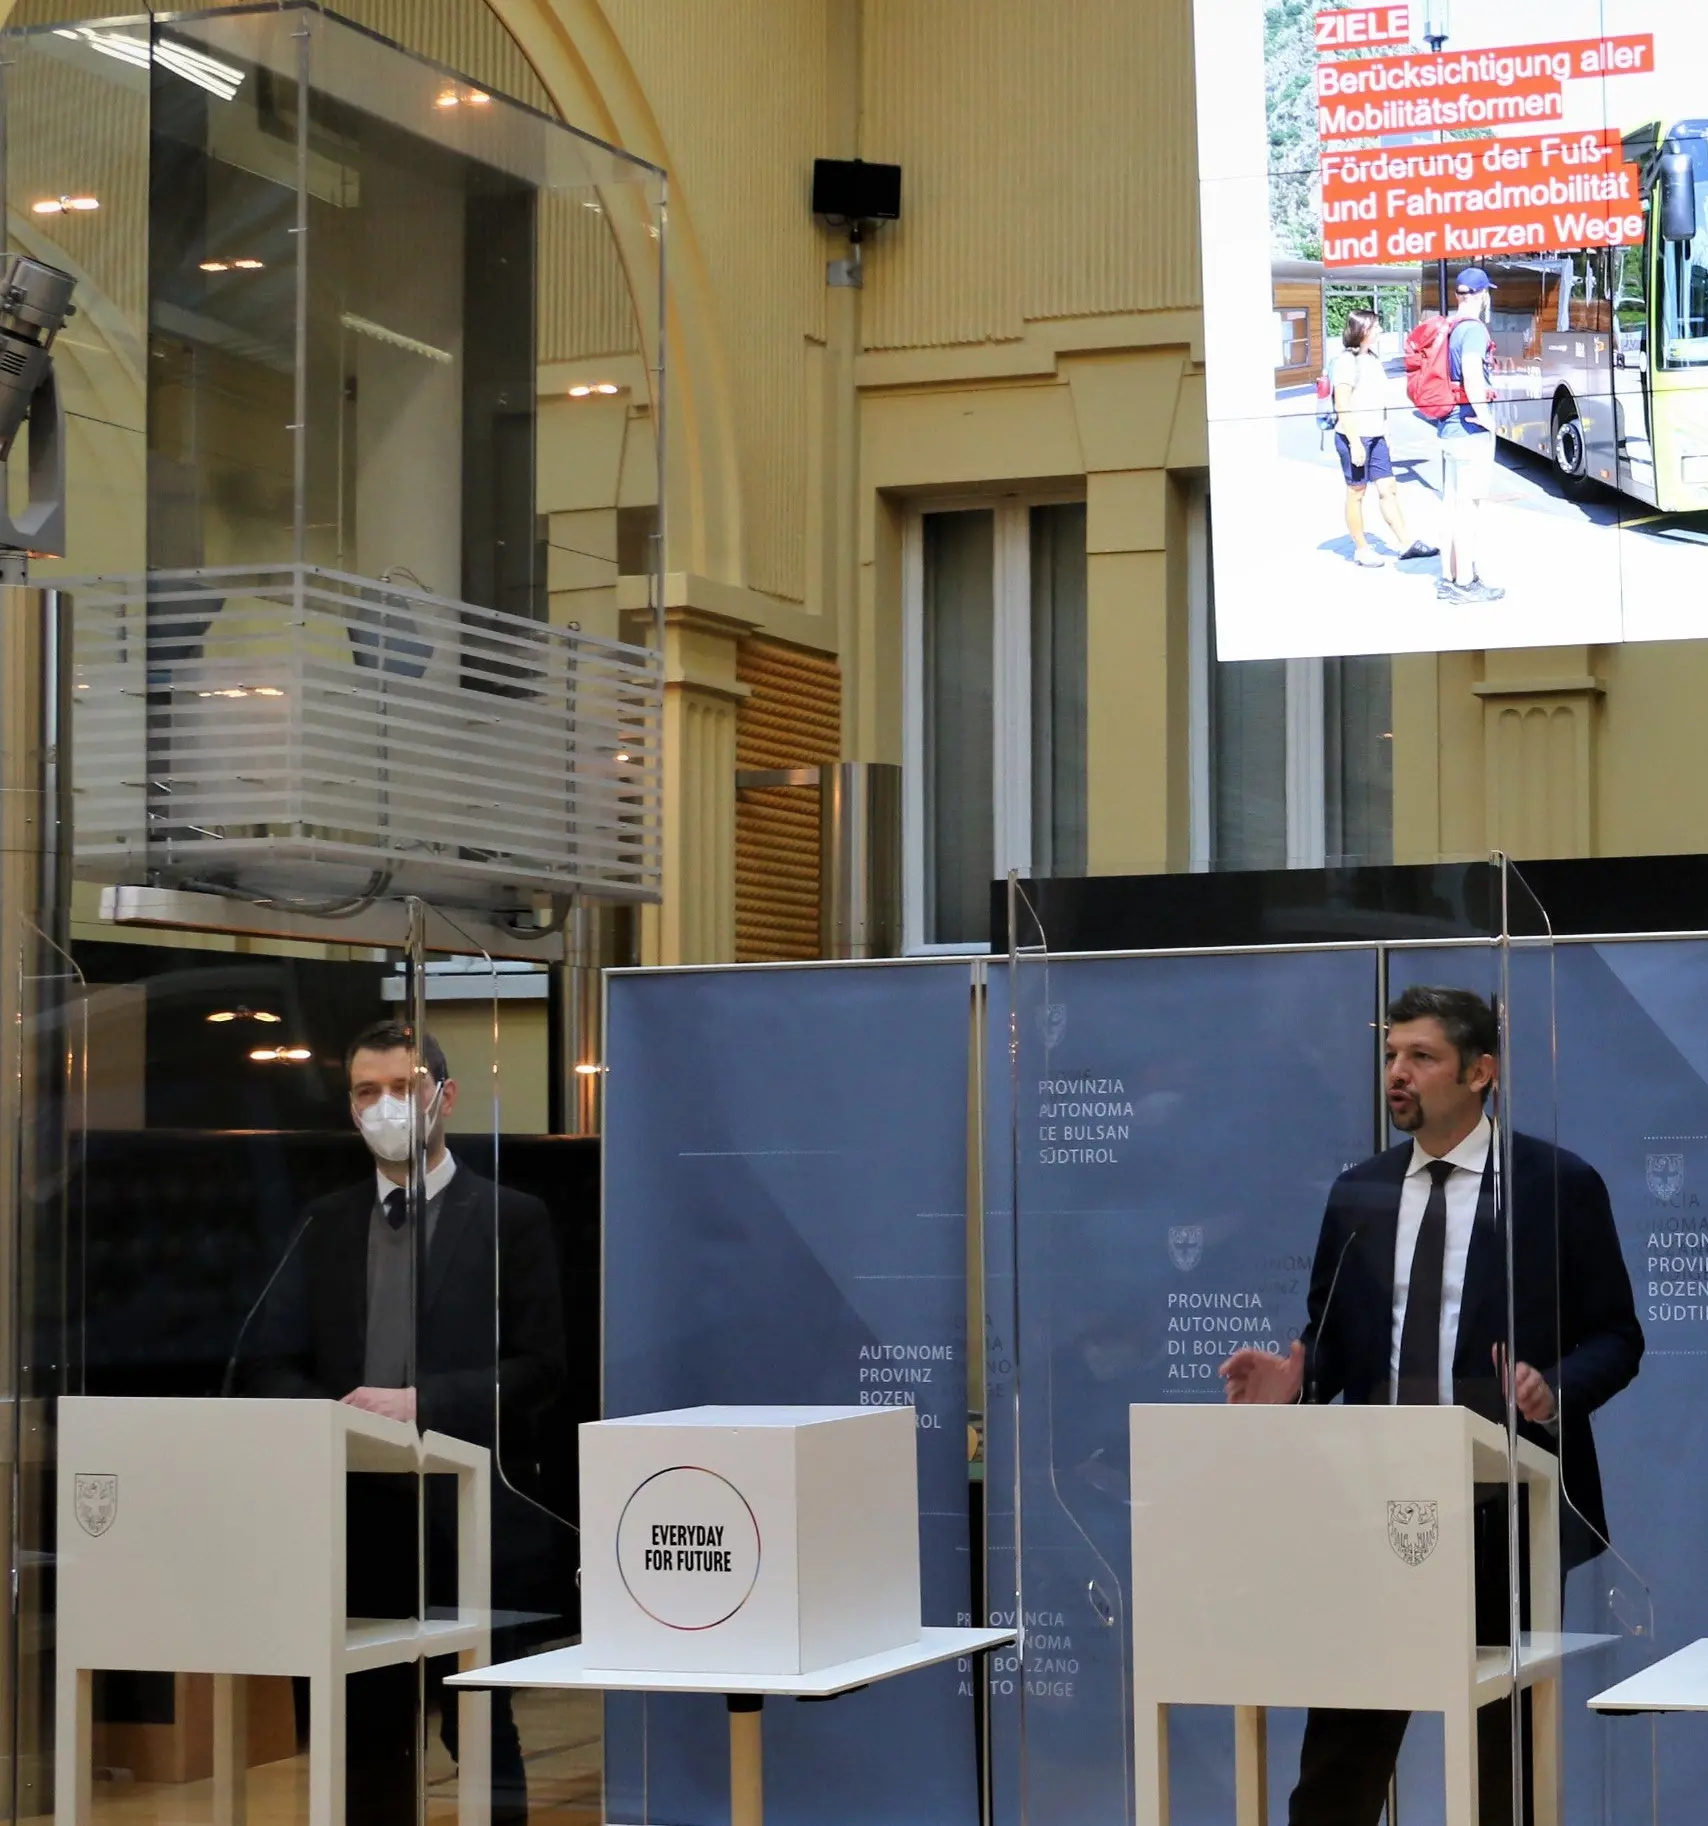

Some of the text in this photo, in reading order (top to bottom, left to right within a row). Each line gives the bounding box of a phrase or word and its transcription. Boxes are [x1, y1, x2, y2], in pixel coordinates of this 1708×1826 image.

[1315, 9, 1409, 44] ZIELE
[1318, 42, 1646, 97] Berücksichtigung aller
[1319, 91, 1562, 135] Mobilitätsformen
[1322, 135, 1614, 186] Förderung der Fuß-
[1323, 172, 1631, 223] und Fahrradmobilität
[1324, 213, 1643, 261] und der kurzen Wege
[1039, 1079, 1125, 1095] PROVINZIA
[1039, 1102, 1134, 1118] AUTONOMA
[1064, 1124, 1129, 1141] BULSAN
[1168, 1293, 1262, 1309] PROVINCIA
[1168, 1317, 1272, 1332] AUTONOMA
[858, 1345, 953, 1361] AUTONOME
[1168, 1340, 1186, 1356] DI
[859, 1368, 933, 1383] PROVINZ
[1168, 1363, 1212, 1379] ALTO
[859, 1390, 915, 1405] BOZEN
[651, 1524, 725, 1548] EVERYDAY
[645, 1549, 732, 1573] FOR FUTURE
[957, 1657, 971, 1674] DI
[1026, 1681, 1075, 1698] ADIGE
